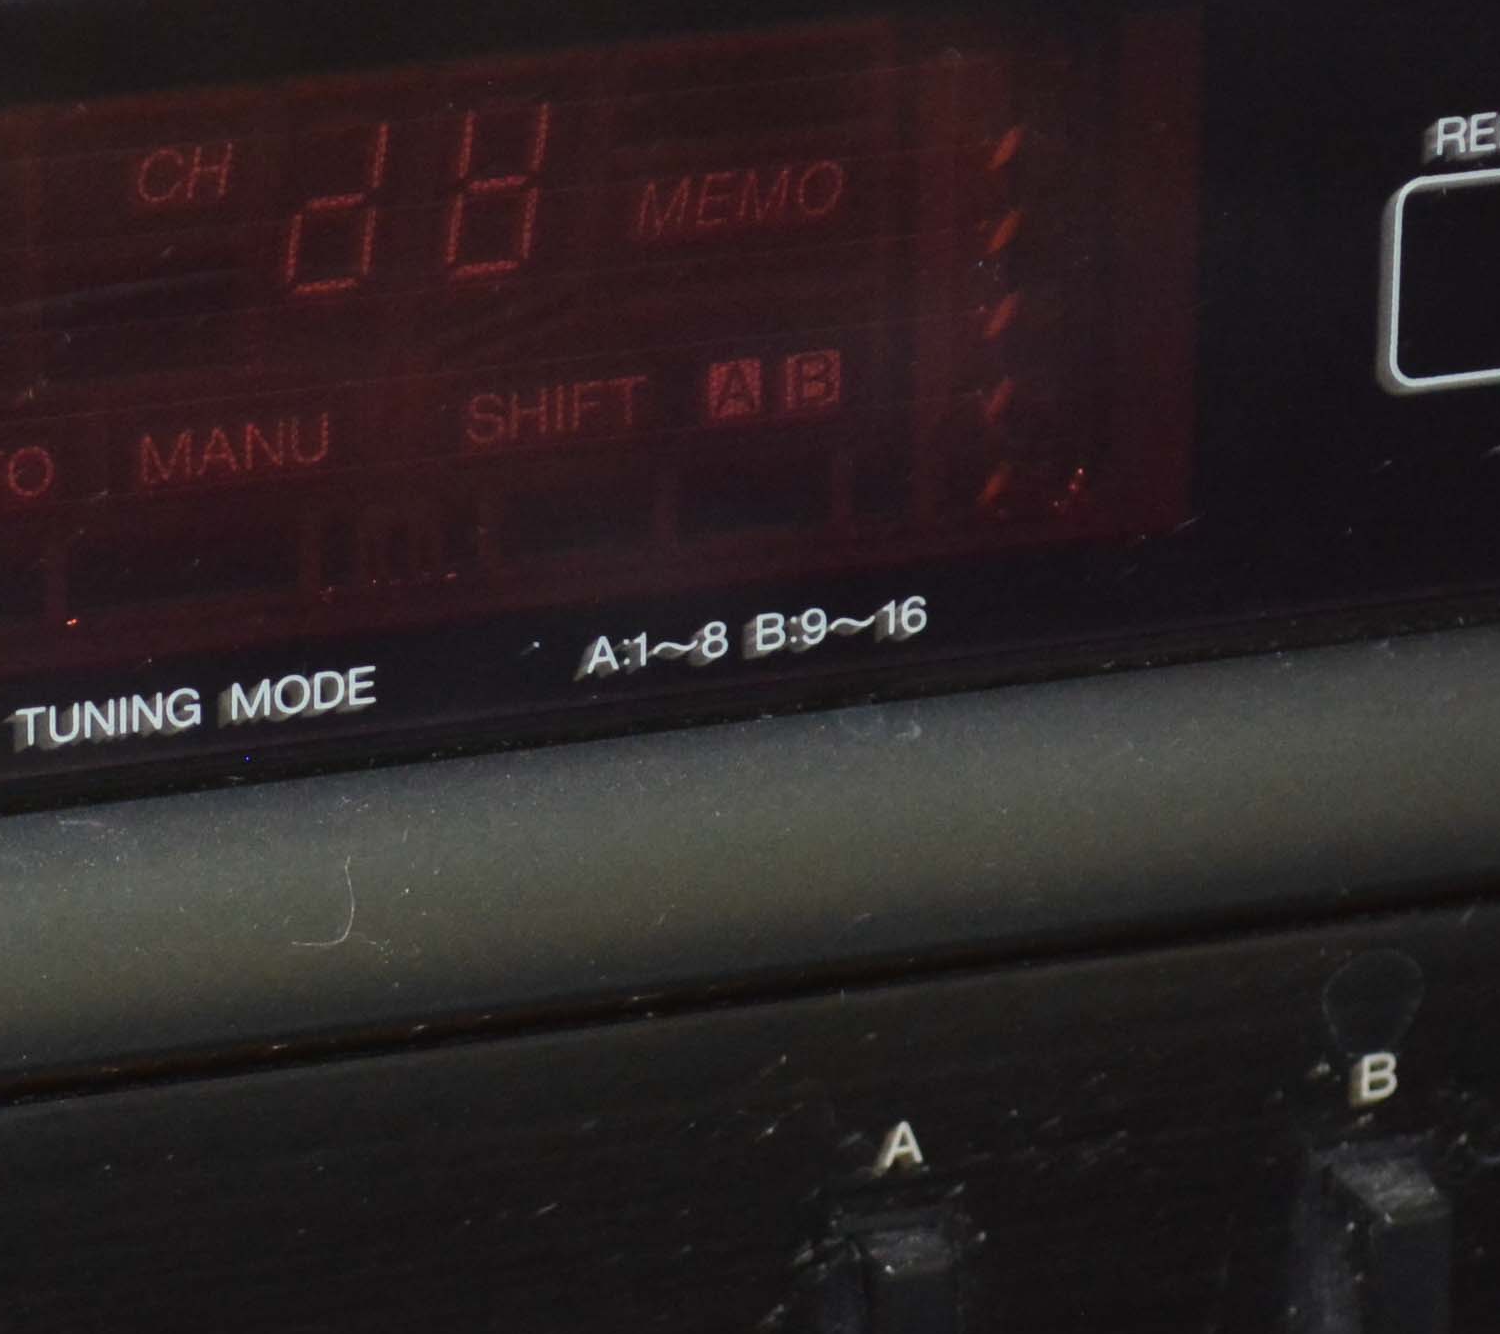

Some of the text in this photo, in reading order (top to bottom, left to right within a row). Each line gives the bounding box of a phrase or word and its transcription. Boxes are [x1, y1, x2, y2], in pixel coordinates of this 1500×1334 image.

[134, 141, 236, 207] CH
[634, 157, 848, 241] MEMO
[464, 347, 842, 449] SHIFT A B
[138, 413, 330, 487] MANU
[10, 667, 378, 749] TUNING MODE
[1352, 1051, 1400, 1103] B
[877, 1121, 924, 1169] A
